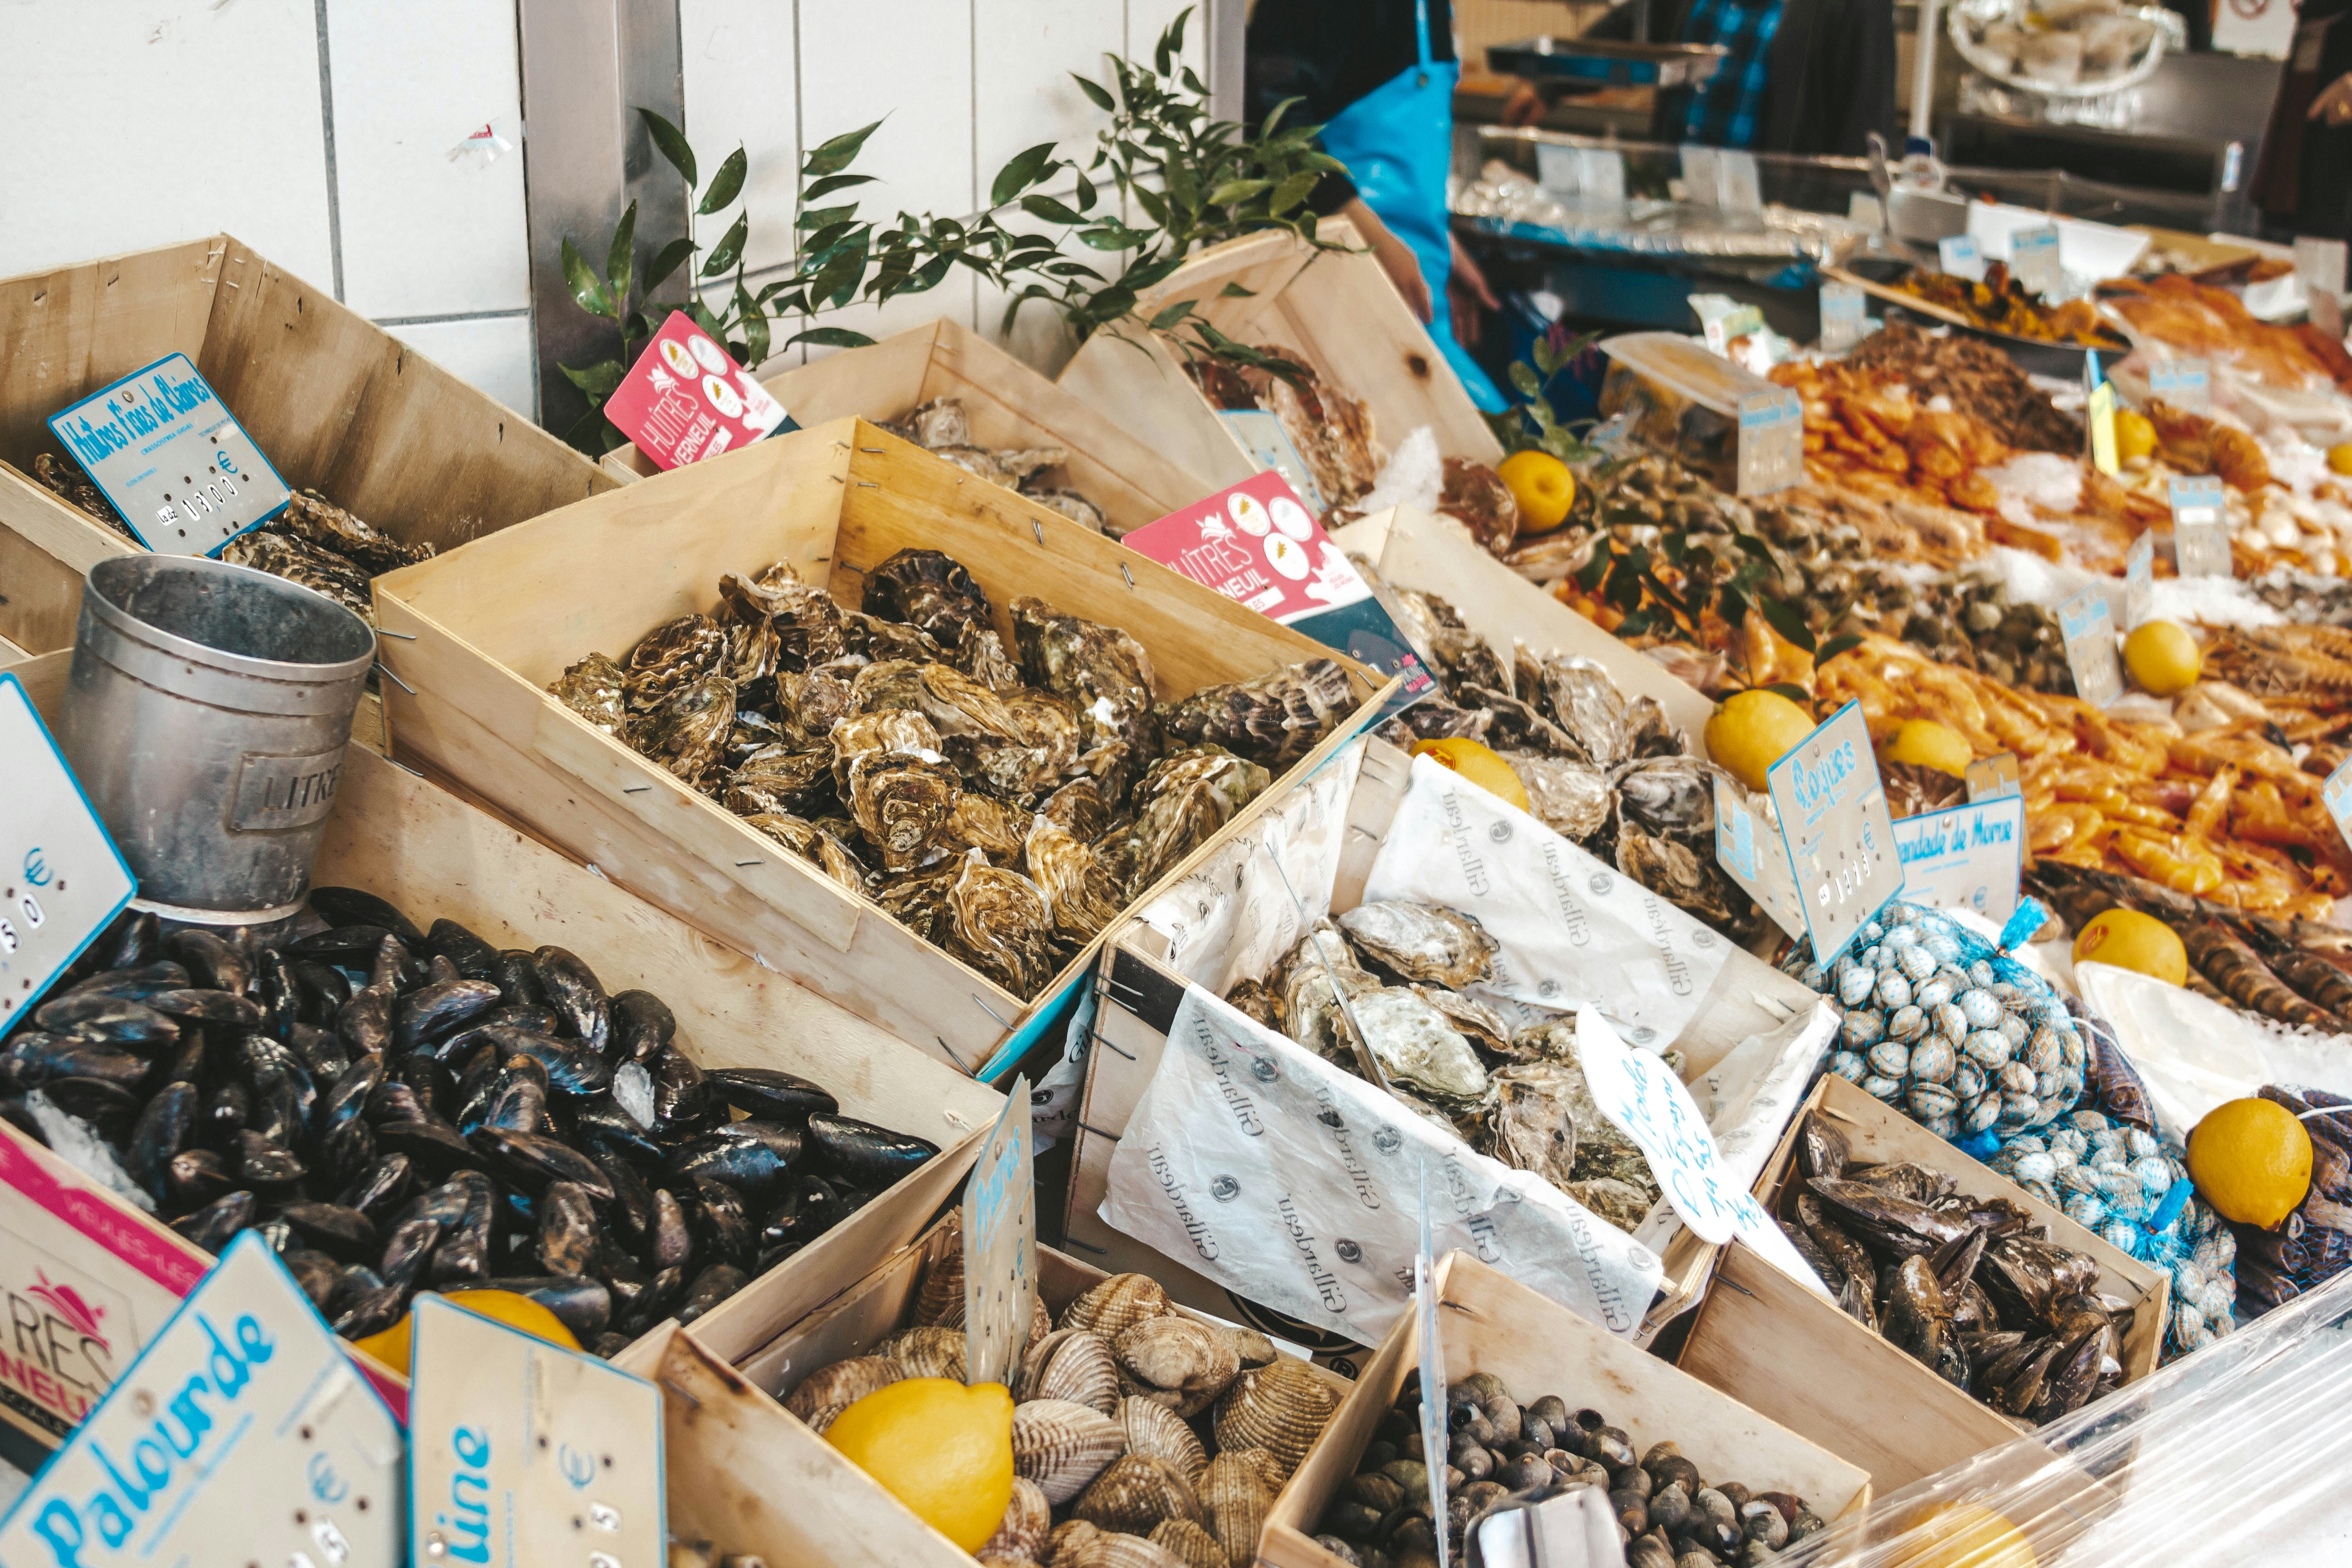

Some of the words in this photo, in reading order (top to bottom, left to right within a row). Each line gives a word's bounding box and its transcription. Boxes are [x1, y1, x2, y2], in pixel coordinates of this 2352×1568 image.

[138, 383, 174, 423] de
[153, 374, 211, 414] Claires
[62, 416, 128, 465] Huîtres
[107, 399, 159, 440] Fines
[640, 382, 698, 456] HUÎTRES
[670, 411, 716, 467] VERNEUIL
[156, 512, 168, 523] la
[166, 508, 178, 519] dz
[1167, 534, 1252, 585] UÎTRES
[1215, 568, 1270, 600] NEUIL
[1792, 740, 1856, 809] Coques
[1896, 818, 1946, 864] andade
[1951, 812, 1967, 852] de
[1972, 808, 2013, 848] Morue
[23, 847, 54, 886] €
[34, 1312, 274, 1568] Palourde
